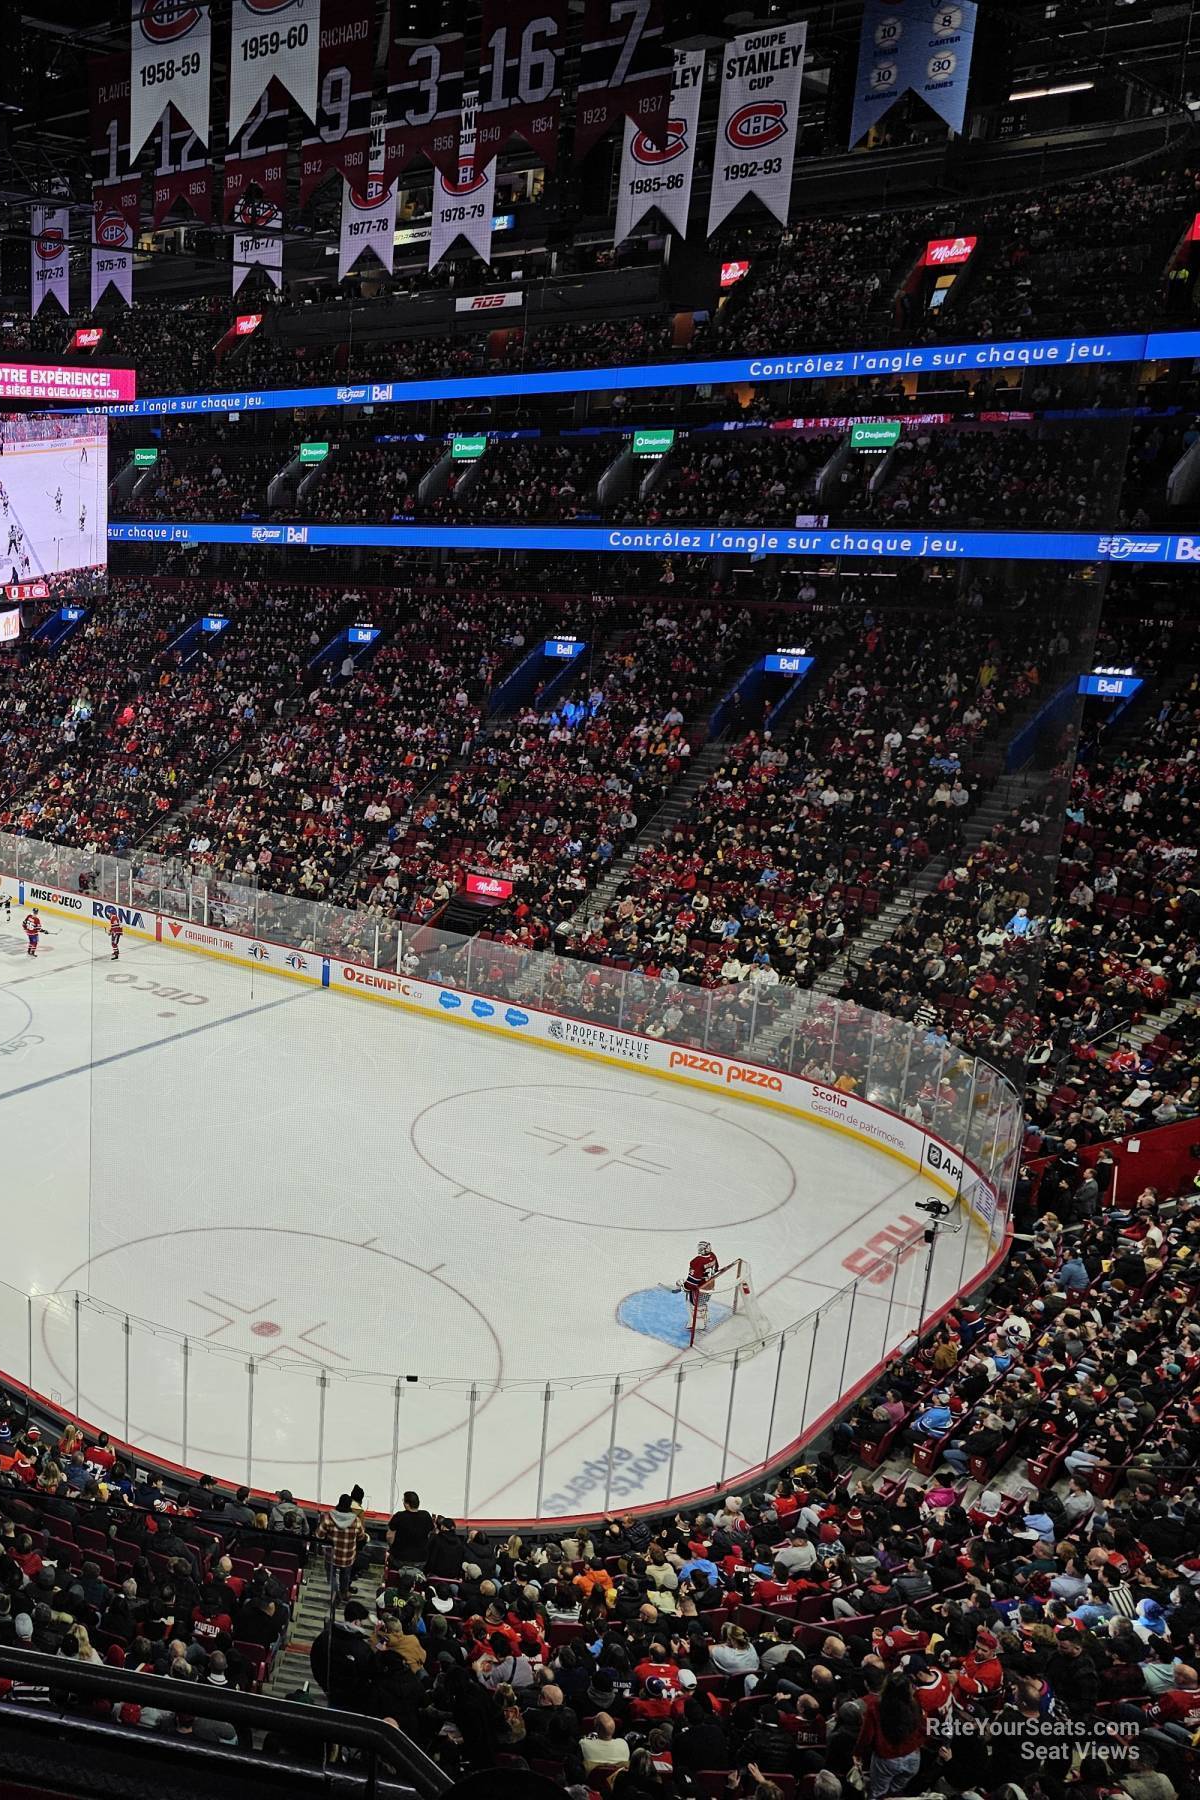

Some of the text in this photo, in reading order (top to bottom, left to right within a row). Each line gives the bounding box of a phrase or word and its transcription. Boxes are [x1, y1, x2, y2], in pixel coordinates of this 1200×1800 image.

[942, 15, 952, 27] 8
[321, 20, 369, 49] RICHARD
[880, 26, 897, 39] 10
[242, 23, 308, 61] 1959-60
[607, 0, 652, 88] 7
[745, 32, 786, 51] COUPE
[928, 36, 961, 47] CARTER
[140, 52, 200, 87] 1958-59
[482, 16, 559, 113] 16
[725, 45, 803, 80] STANLEY
[932, 60, 951, 72] 30
[404, 44, 441, 126] 3
[749, 76, 774, 91] CUP
[876, 70, 892, 83] 10
[98, 80, 131, 104] PLANTE
[318, 65, 351, 143] 9
[638, 95, 663, 114] 1937
[531, 116, 553, 133] 1954
[583, 107, 607, 125] 1923
[433, 135, 453, 151] 1956
[479, 127, 500, 143] 1940
[104, 119, 122, 187] 1
[344, 152, 363, 167] 1960
[387, 144, 405, 159] 1941
[265, 167, 282, 181] 1961
[303, 160, 322, 174] 1942
[723, 158, 782, 180] 1992-93
[189, 181, 206, 195] 1963
[226, 174, 243, 189] 1947
[629, 173, 684, 195] 1985-86
[121, 195, 137, 207] 1963
[156, 188, 170, 201] 1951
[440, 204, 485, 223] 1978-79
[348, 218, 389, 235] 1977-78
[931, 244, 972, 262] Molson
[96, 257, 127, 272] 1975-76
[36, 268, 64, 281] 1972-73
[470, 296, 505, 309] RDS
[749, 342, 1112, 377] Contrôlez l'angle sur chaque jeu.
[30, 368, 110, 387] EXPÉRIENCE!
[6, 383, 31, 396] SIÈGE
[33, 386, 45, 397] EN
[48, 387, 92, 398] QUELQUES
[94, 387, 119, 399] CLICS!
[372, 386, 393, 400] Bell
[180, 395, 265, 411] sur chaque jeu.
[865, 431, 896, 439] Desjardins
[128, 526, 167, 541] chaque
[287, 527, 308, 543] Bell
[609, 531, 964, 555] Contrôlez l'angle sur chaque jeu.
[357, 631, 372, 641] Bell
[557, 644, 572, 656] Bell
[779, 658, 799, 671] Bell
[1097, 679, 1123, 694] Bell
[92, 900, 146, 929] RONA
[184, 929, 216, 946] CANADIAN
[218, 938, 234, 951] TIRE
[134, 980, 210, 1007] CIBC
[566, 1023, 649, 1054] PROPER TWELVE
[566, 1034, 649, 1062] IRISH WHISKEY
[669, 1051, 783, 1092] pizza pizza
[812, 1086, 848, 1109] Scotia
[810, 1100, 906, 1150] Gestion de patrimoine.
[941, 1157, 963, 1182] App
[542, 1438, 683, 1515] sports experts
